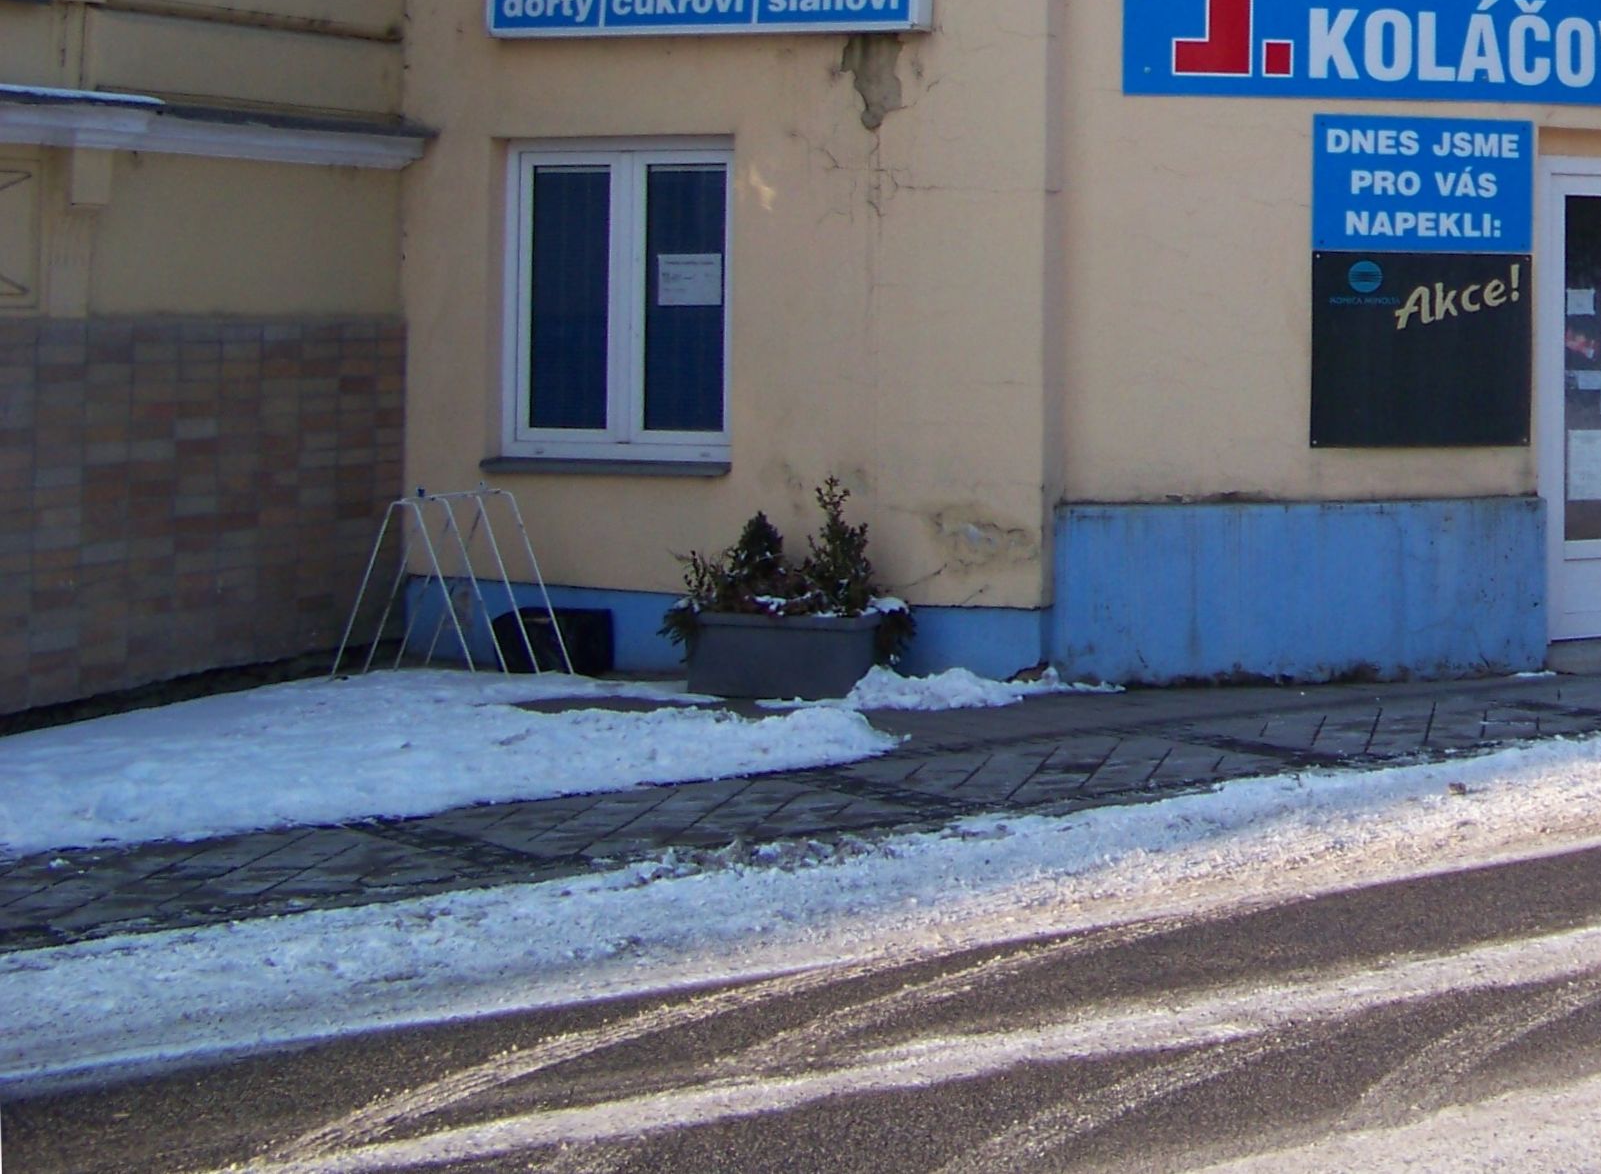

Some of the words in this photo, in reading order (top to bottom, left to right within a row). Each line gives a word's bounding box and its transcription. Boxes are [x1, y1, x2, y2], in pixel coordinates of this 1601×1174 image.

[1326, 128, 1420, 156] DNES
[1432, 131, 1520, 158] JSME
[1350, 169, 1421, 197] PRO
[1434, 166, 1498, 198] VÁS
[1345, 210, 1502, 238] NAPEKLI:
[1394, 263, 1520, 330] Akce!
